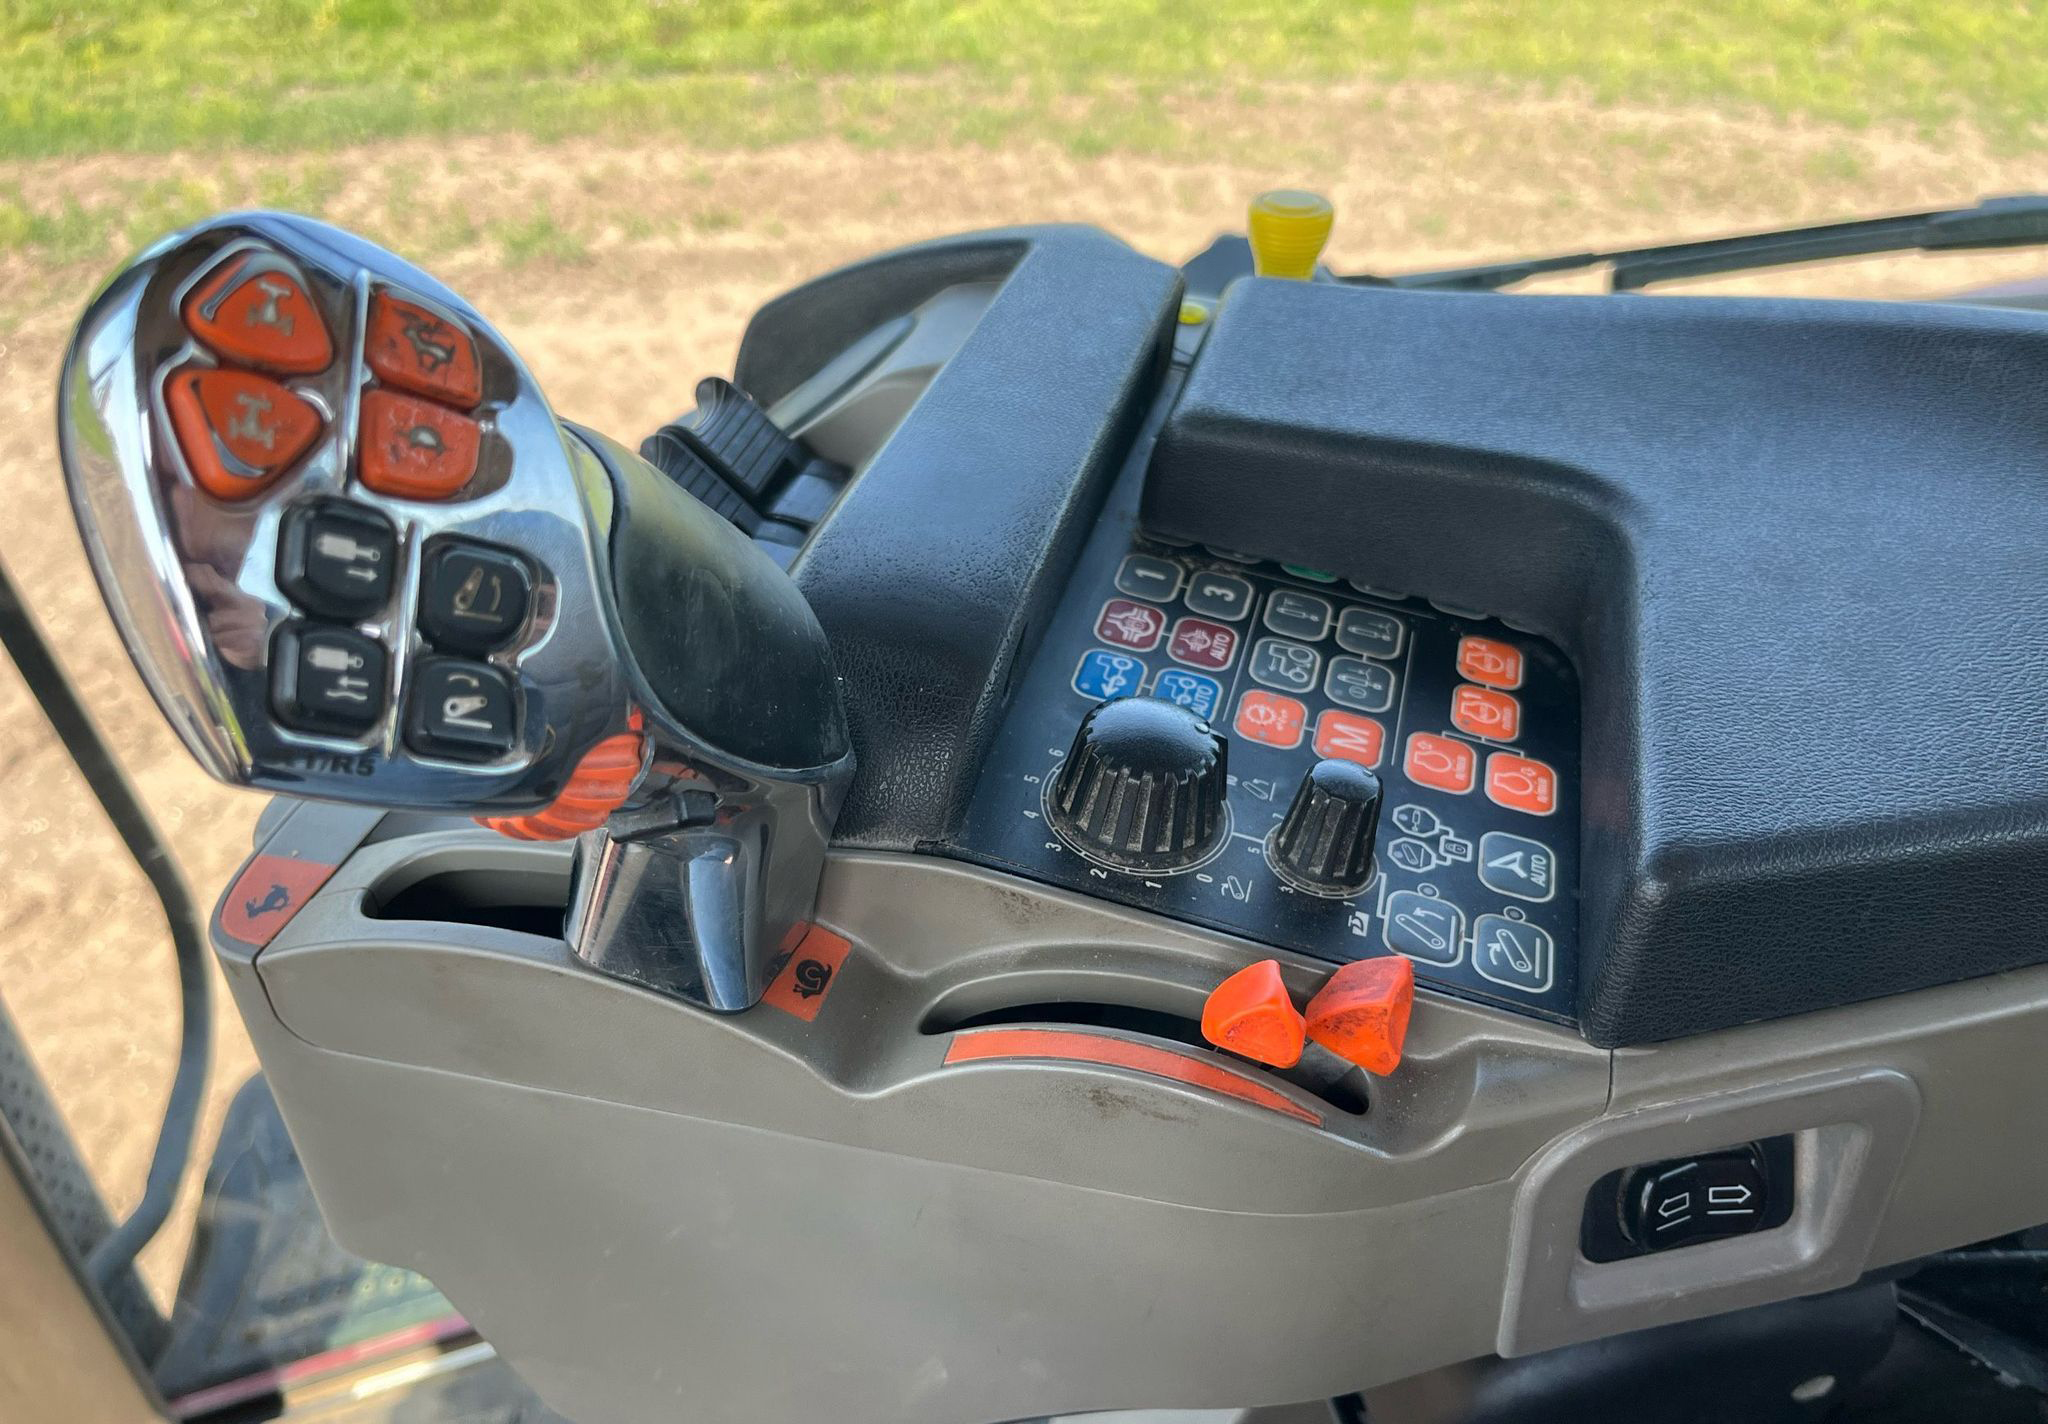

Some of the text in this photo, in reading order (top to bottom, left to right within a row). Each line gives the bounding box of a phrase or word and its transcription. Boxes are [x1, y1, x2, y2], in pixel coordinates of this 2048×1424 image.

[1135, 567, 1167, 581] 1
[1203, 586, 1236, 602] 3
[1209, 633, 1231, 662] AUTO
[1330, 723, 1370, 753] M
[1049, 747, 1065, 757] 6
[1024, 774, 1040, 784] 5
[1023, 809, 1040, 819] 4
[1045, 841, 1063, 852] 3
[1247, 846, 1260, 854] 5
[1090, 868, 1108, 880] 2
[1530, 854, 1547, 888] AUTO
[1196, 873, 1213, 883] 0
[1145, 880, 1162, 889] 1
[1278, 886, 1294, 894] 3
